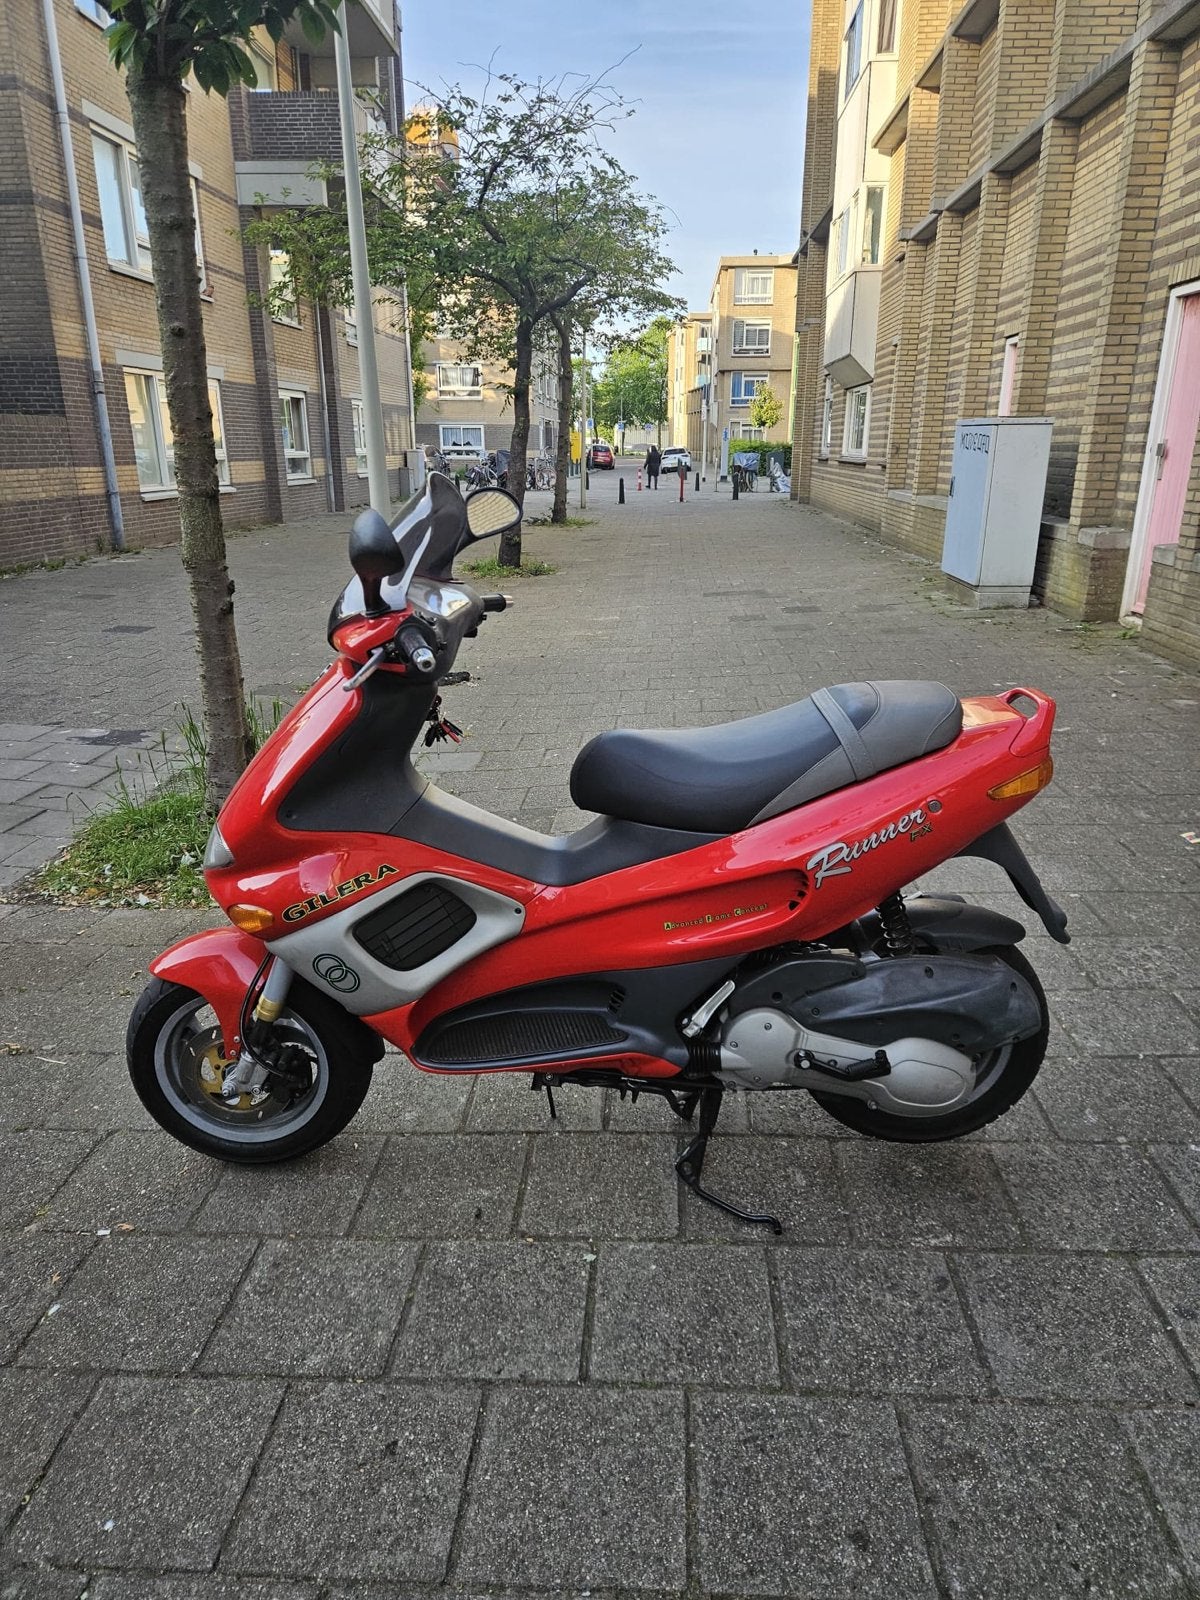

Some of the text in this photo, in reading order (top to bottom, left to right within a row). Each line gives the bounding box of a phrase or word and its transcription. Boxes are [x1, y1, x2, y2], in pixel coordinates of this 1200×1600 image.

[806, 807, 928, 890] Runner
[909, 821, 934, 842] FX
[281, 863, 399, 923] GILERA
[664, 918, 704, 931] Advanced
